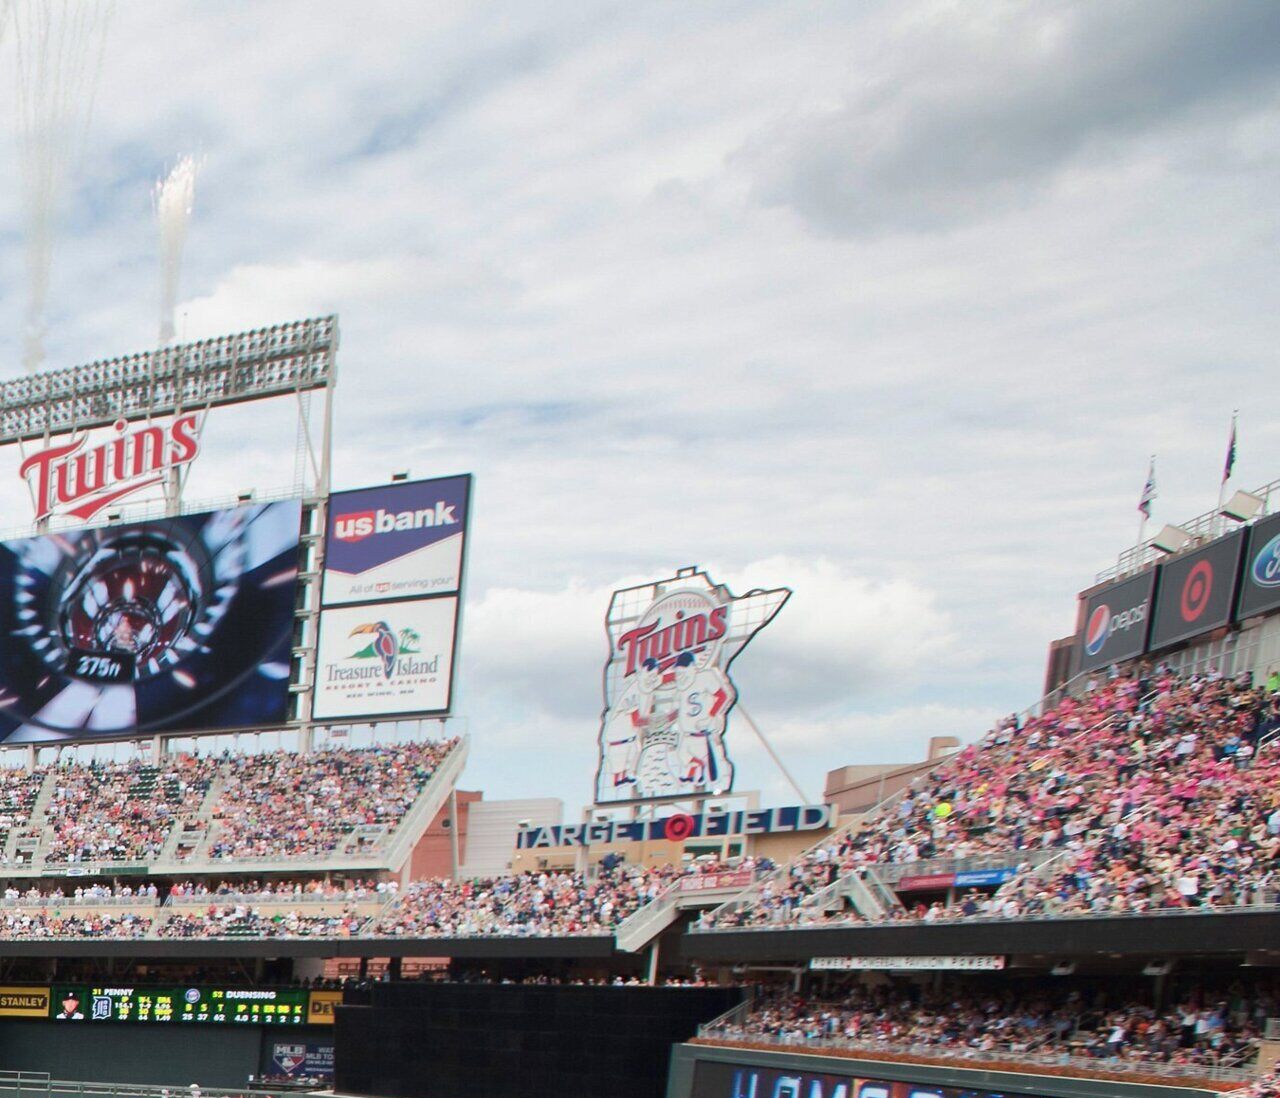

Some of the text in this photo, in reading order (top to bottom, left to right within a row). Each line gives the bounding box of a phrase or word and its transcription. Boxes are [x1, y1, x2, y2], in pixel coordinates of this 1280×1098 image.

[18, 411, 200, 522] Twins
[1109, 598, 1149, 638] pepsi
[617, 605, 729, 679] Twins
[325, 653, 440, 683] Treasure Island
[517, 804, 830, 849] TARGET FIELD
[0, 997, 45, 1007] STANLEY
[104, 988, 134, 996] PENNY
[226, 991, 277, 999] DUENSING
[276, 1045, 304, 1054] MLB
